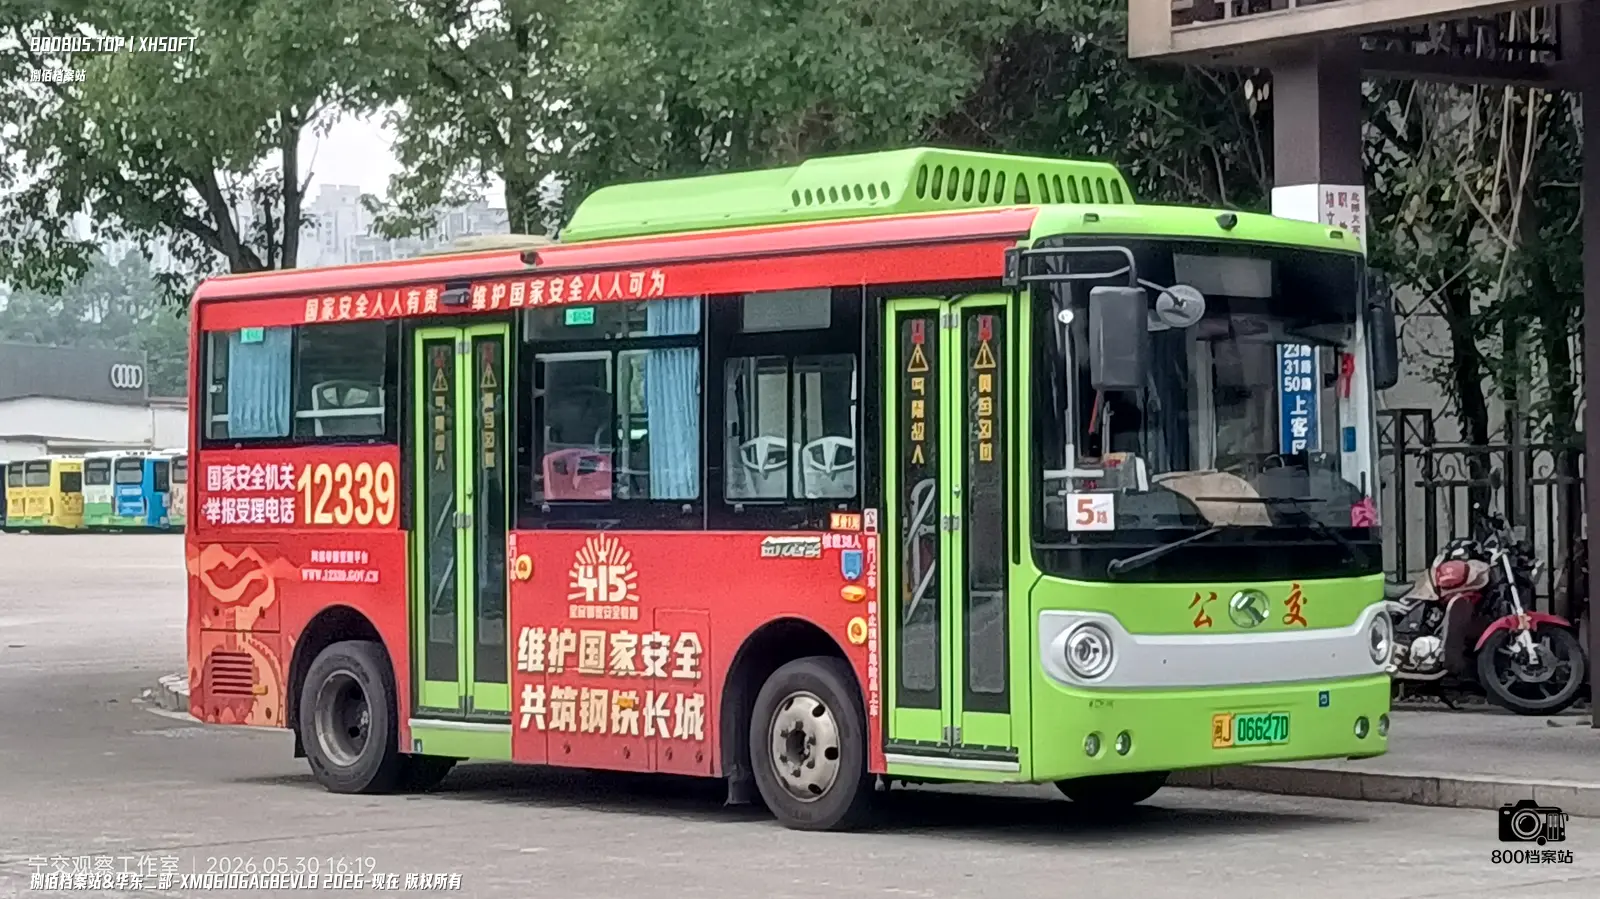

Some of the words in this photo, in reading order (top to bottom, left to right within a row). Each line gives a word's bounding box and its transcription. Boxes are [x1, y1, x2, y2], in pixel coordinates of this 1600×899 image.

[304, 287, 439, 323] 国家安全人人有责
[472, 270, 667, 310] 维护国家安全人人可为
[207, 463, 296, 492] 国家安全机关
[297, 461, 396, 526] 12339
[204, 497, 296, 525] 举报受理电话
[576, 564, 628, 602] 415
[1188, 592, 1217, 628] 公
[1282, 583, 1308, 627] 交
[517, 627, 703, 679] 维护国家安全
[519, 684, 705, 741] 共筑钢铁长城
